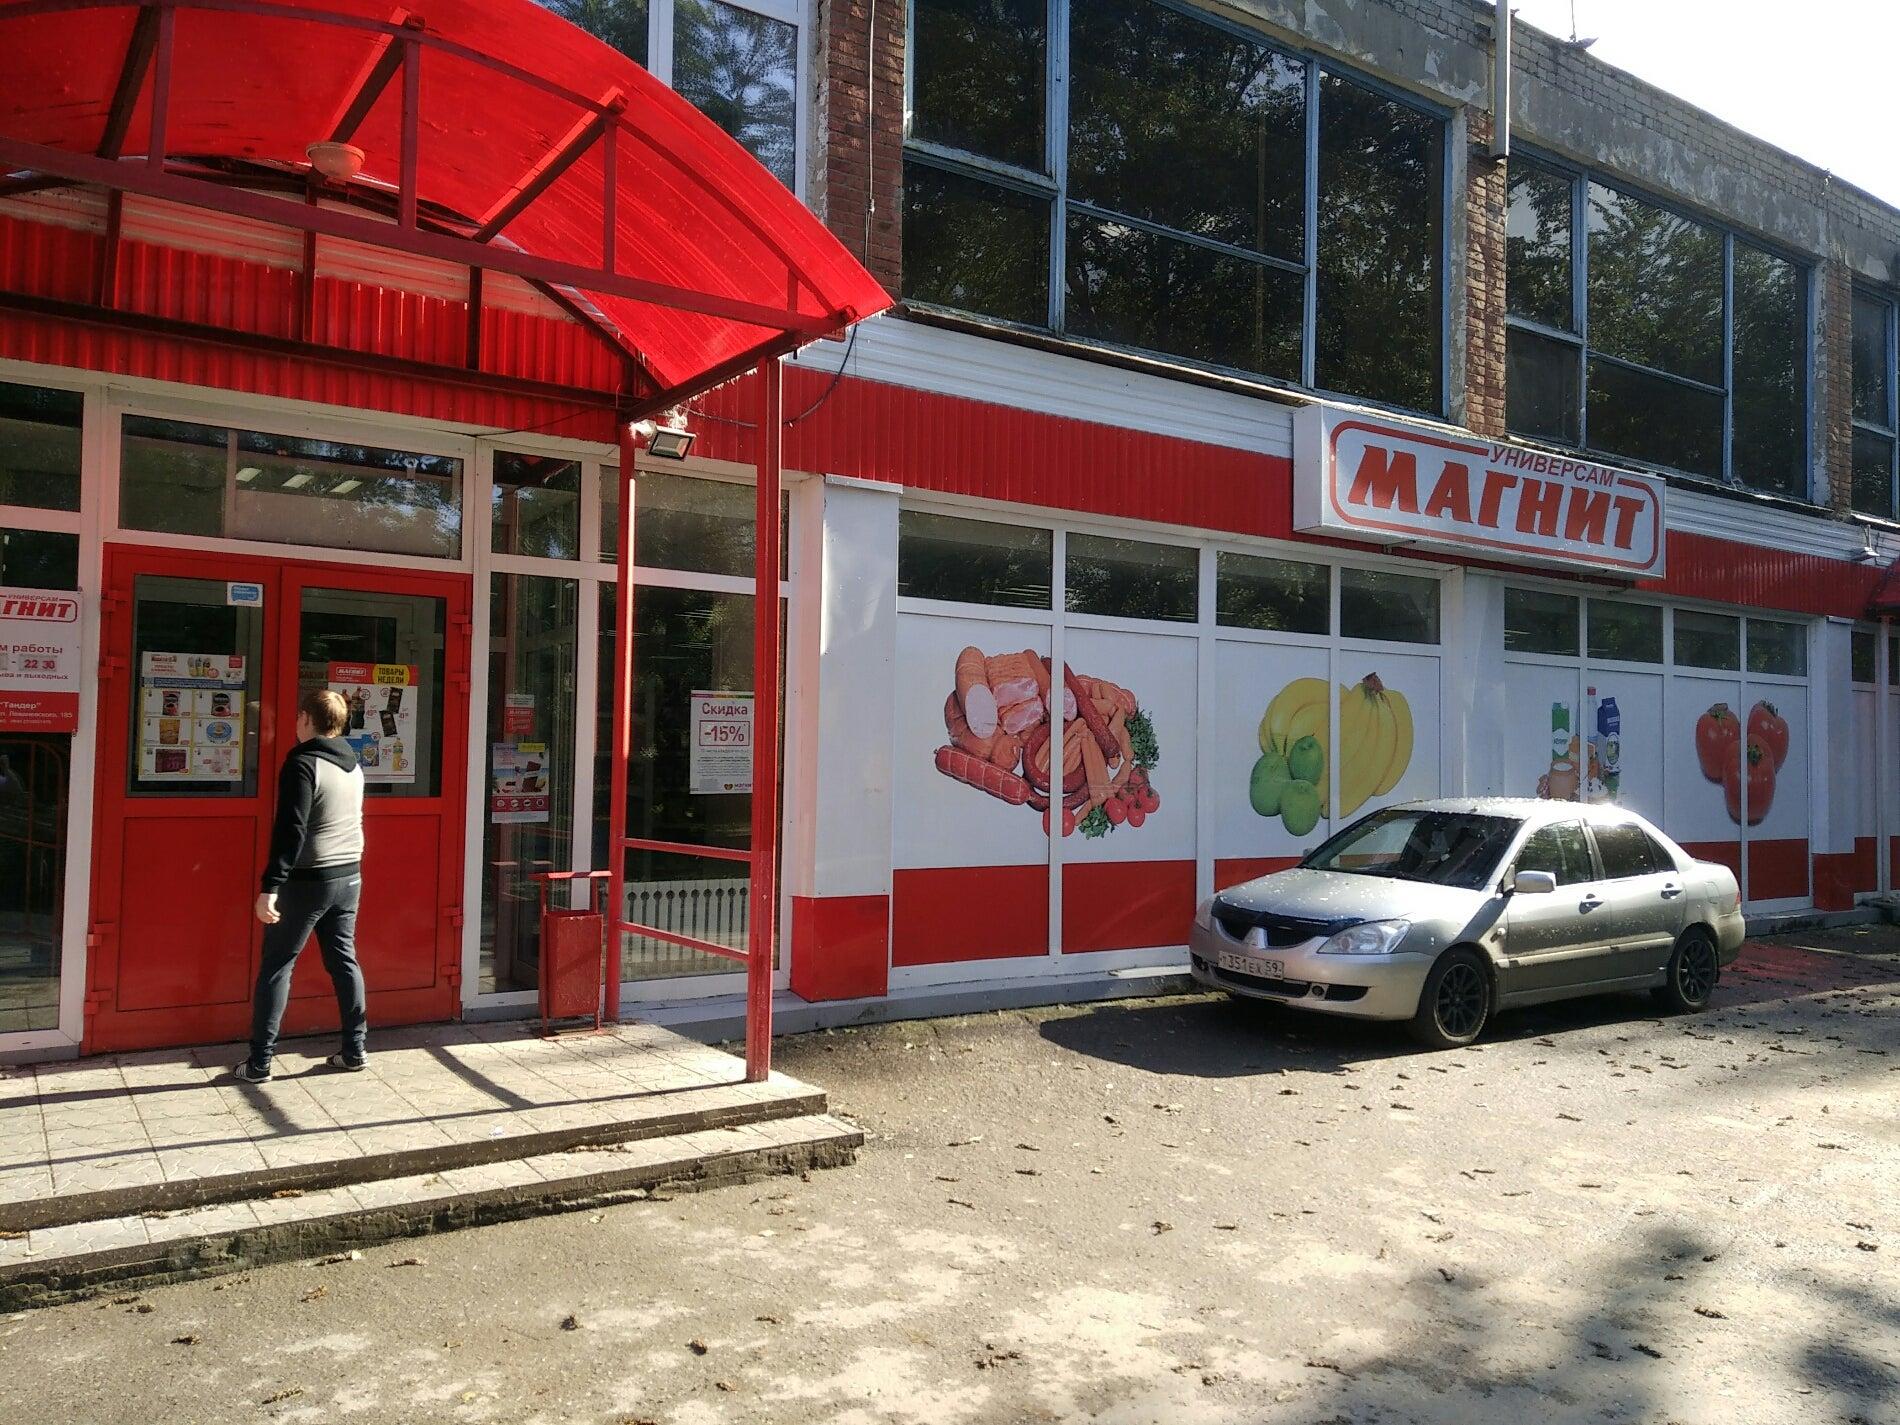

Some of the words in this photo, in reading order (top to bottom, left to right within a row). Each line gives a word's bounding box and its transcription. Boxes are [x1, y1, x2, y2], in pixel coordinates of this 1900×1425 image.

[1490, 446, 1615, 487] УНИВЕРСАМ
[1347, 445, 1645, 550] МАГНИТ
[12, 643, 63, 654] работы
[24, 659, 38, 669] 22
[378, 667, 405, 676] ТОВАРЫ
[377, 675, 405, 684] НЕДЕЛИ
[702, 702, 748, 716] Скидка
[704, 725, 745, 742] -15%
